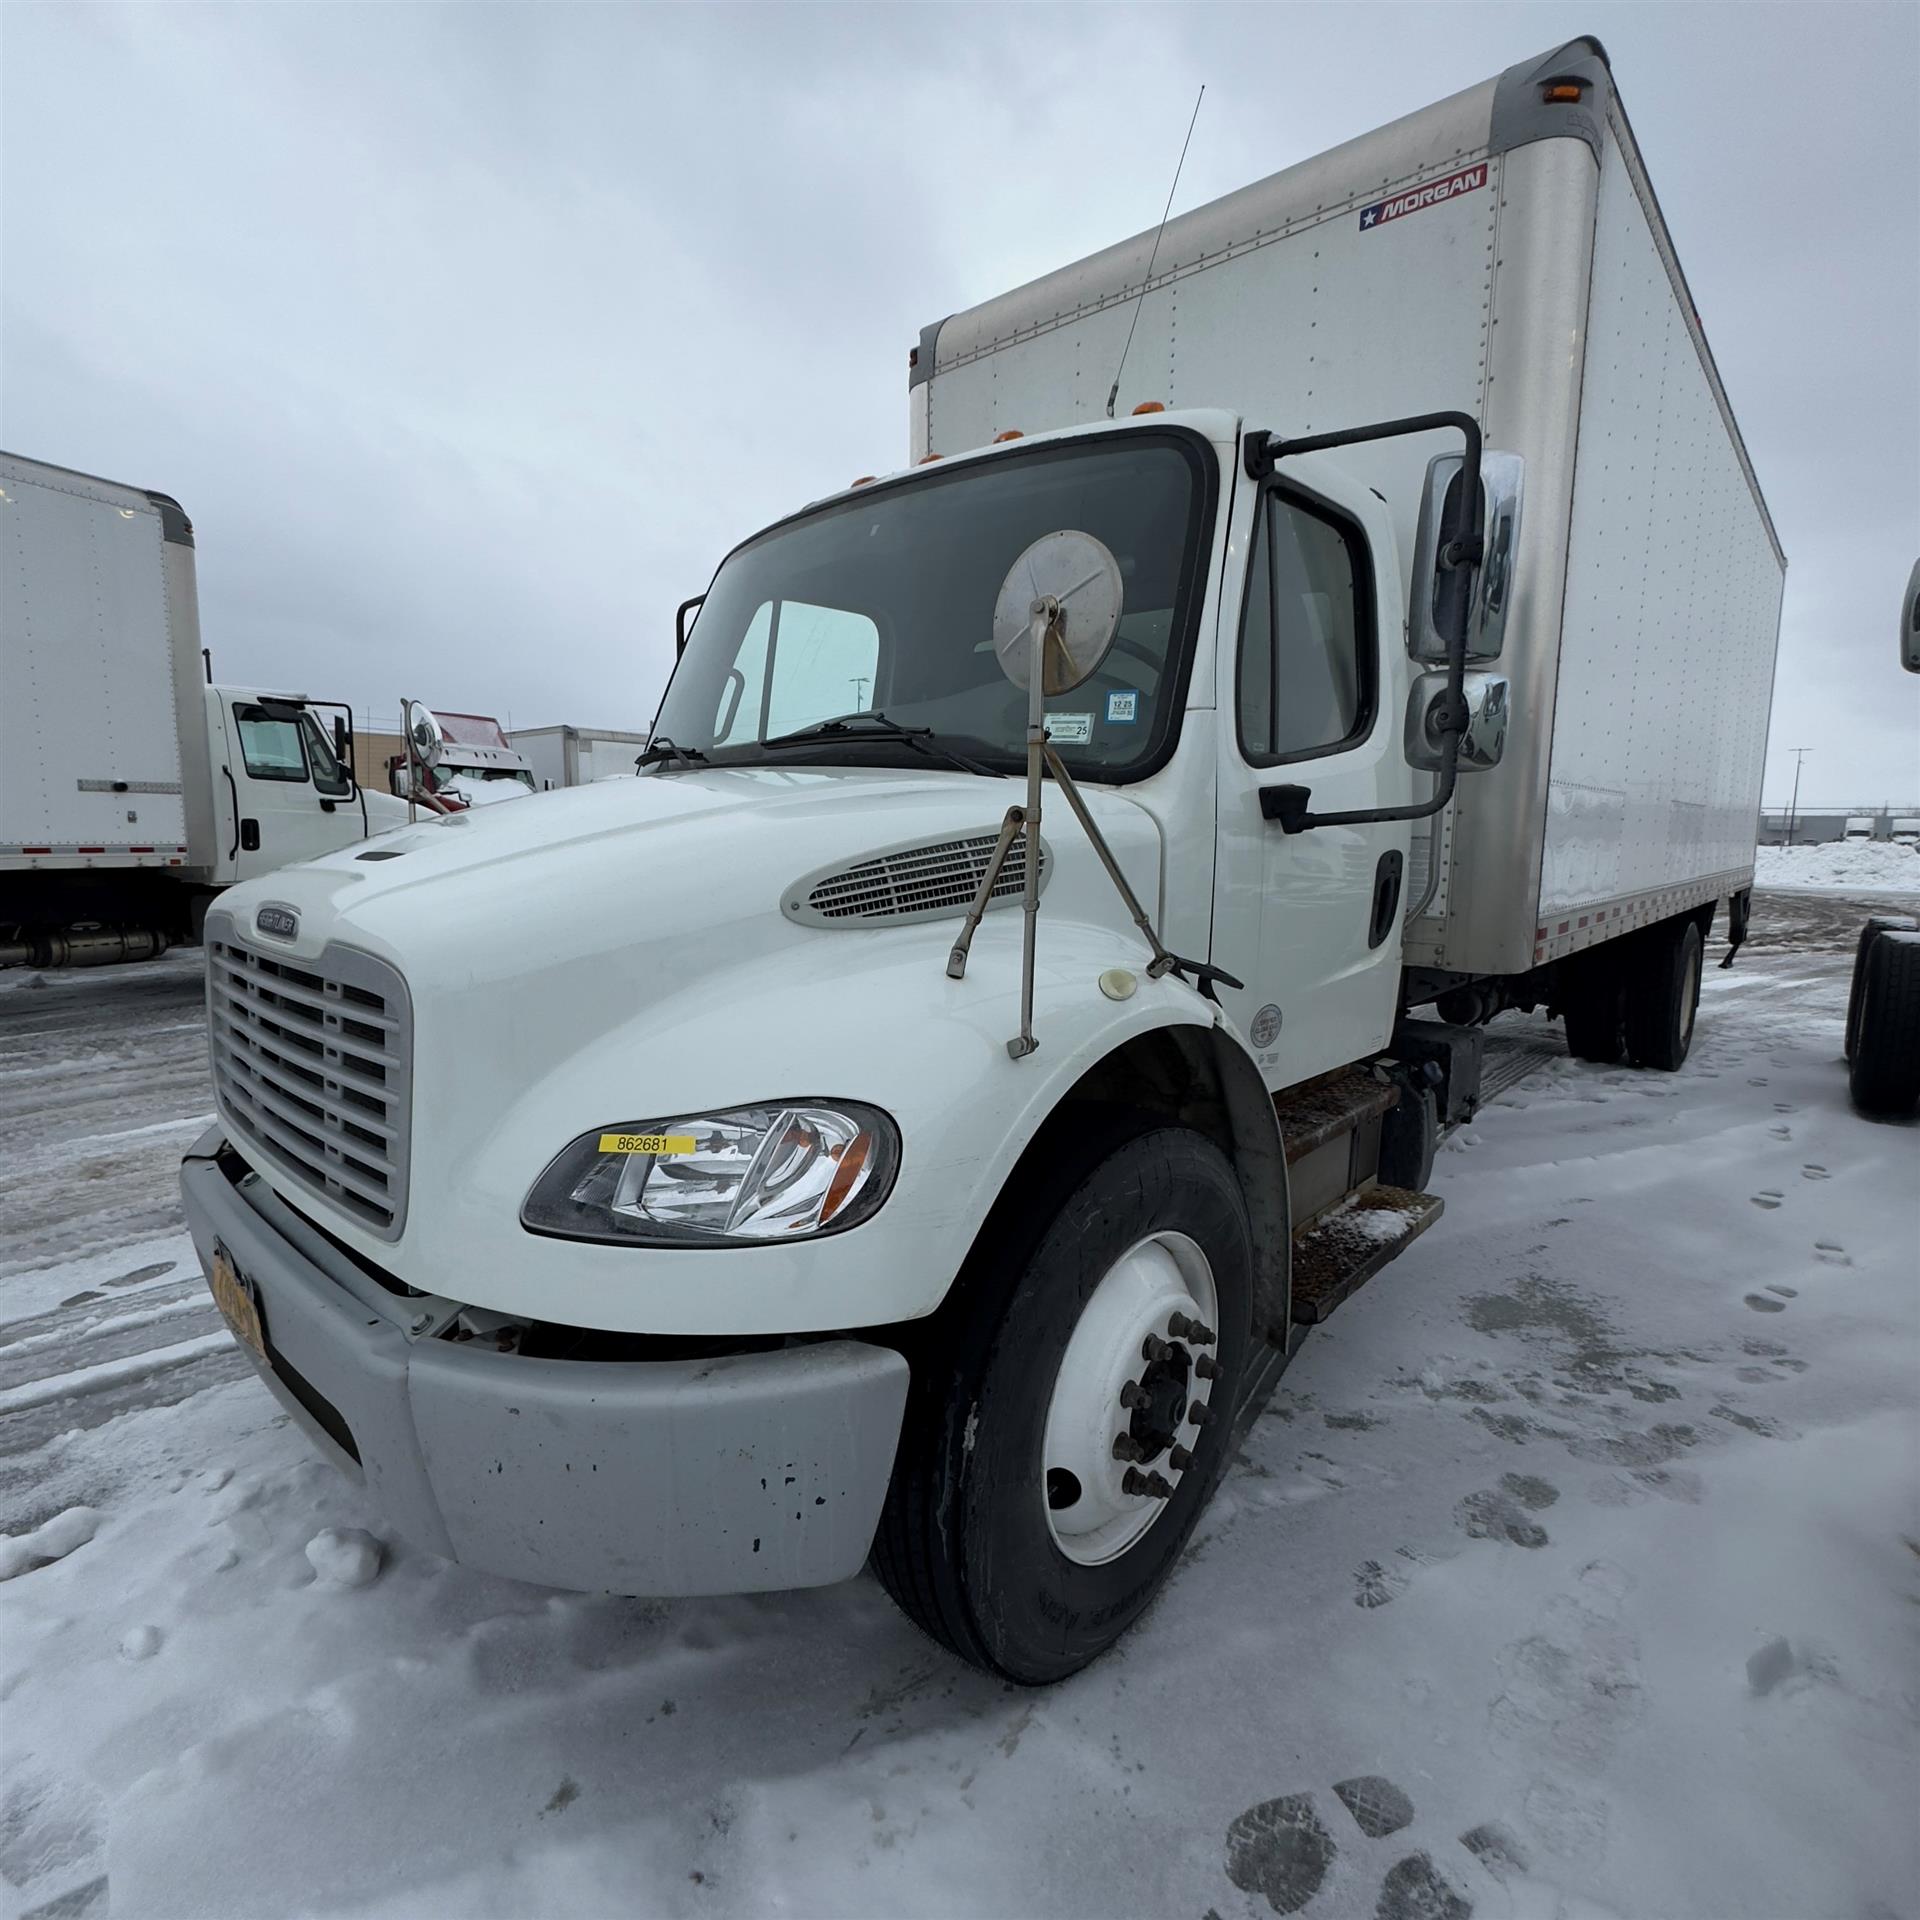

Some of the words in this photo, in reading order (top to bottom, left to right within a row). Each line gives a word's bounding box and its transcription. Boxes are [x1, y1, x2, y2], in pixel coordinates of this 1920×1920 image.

[1381, 170, 1482, 220] MORGAN
[1113, 700, 1122, 708] 12
[1076, 726, 1088, 735] 25
[617, 1136, 668, 1151] 862681
